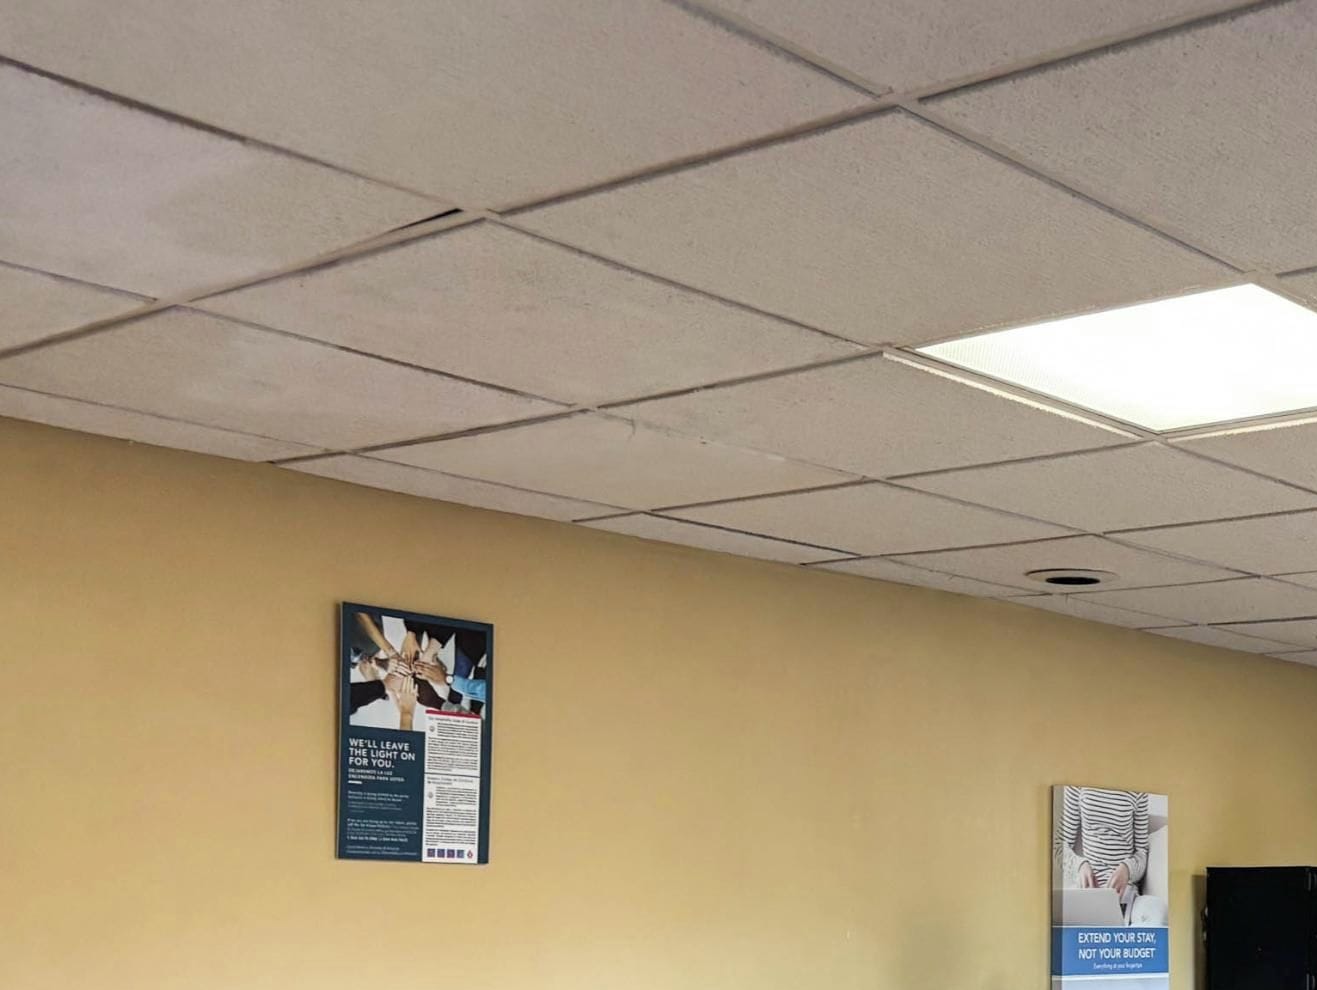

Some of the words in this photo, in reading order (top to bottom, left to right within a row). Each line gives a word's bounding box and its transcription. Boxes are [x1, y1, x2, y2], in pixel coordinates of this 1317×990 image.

[348, 738, 378, 749] WE'LL
[380, 740, 410, 751] LEAVE
[348, 747, 368, 757] THE
[370, 749, 399, 760] LIGHT
[400, 752, 416, 761] ON
[348, 757, 369, 767] FOR
[371, 758, 395, 768] YOU.
[1078, 932, 1111, 944] EXTEND
[1113, 932, 1135, 943] YOUR
[1137, 932, 1157, 945] STAY,
[1078, 948, 1097, 960] NOT
[1099, 948, 1121, 959] YOUR
[1123, 948, 1156, 959] BUDGET
